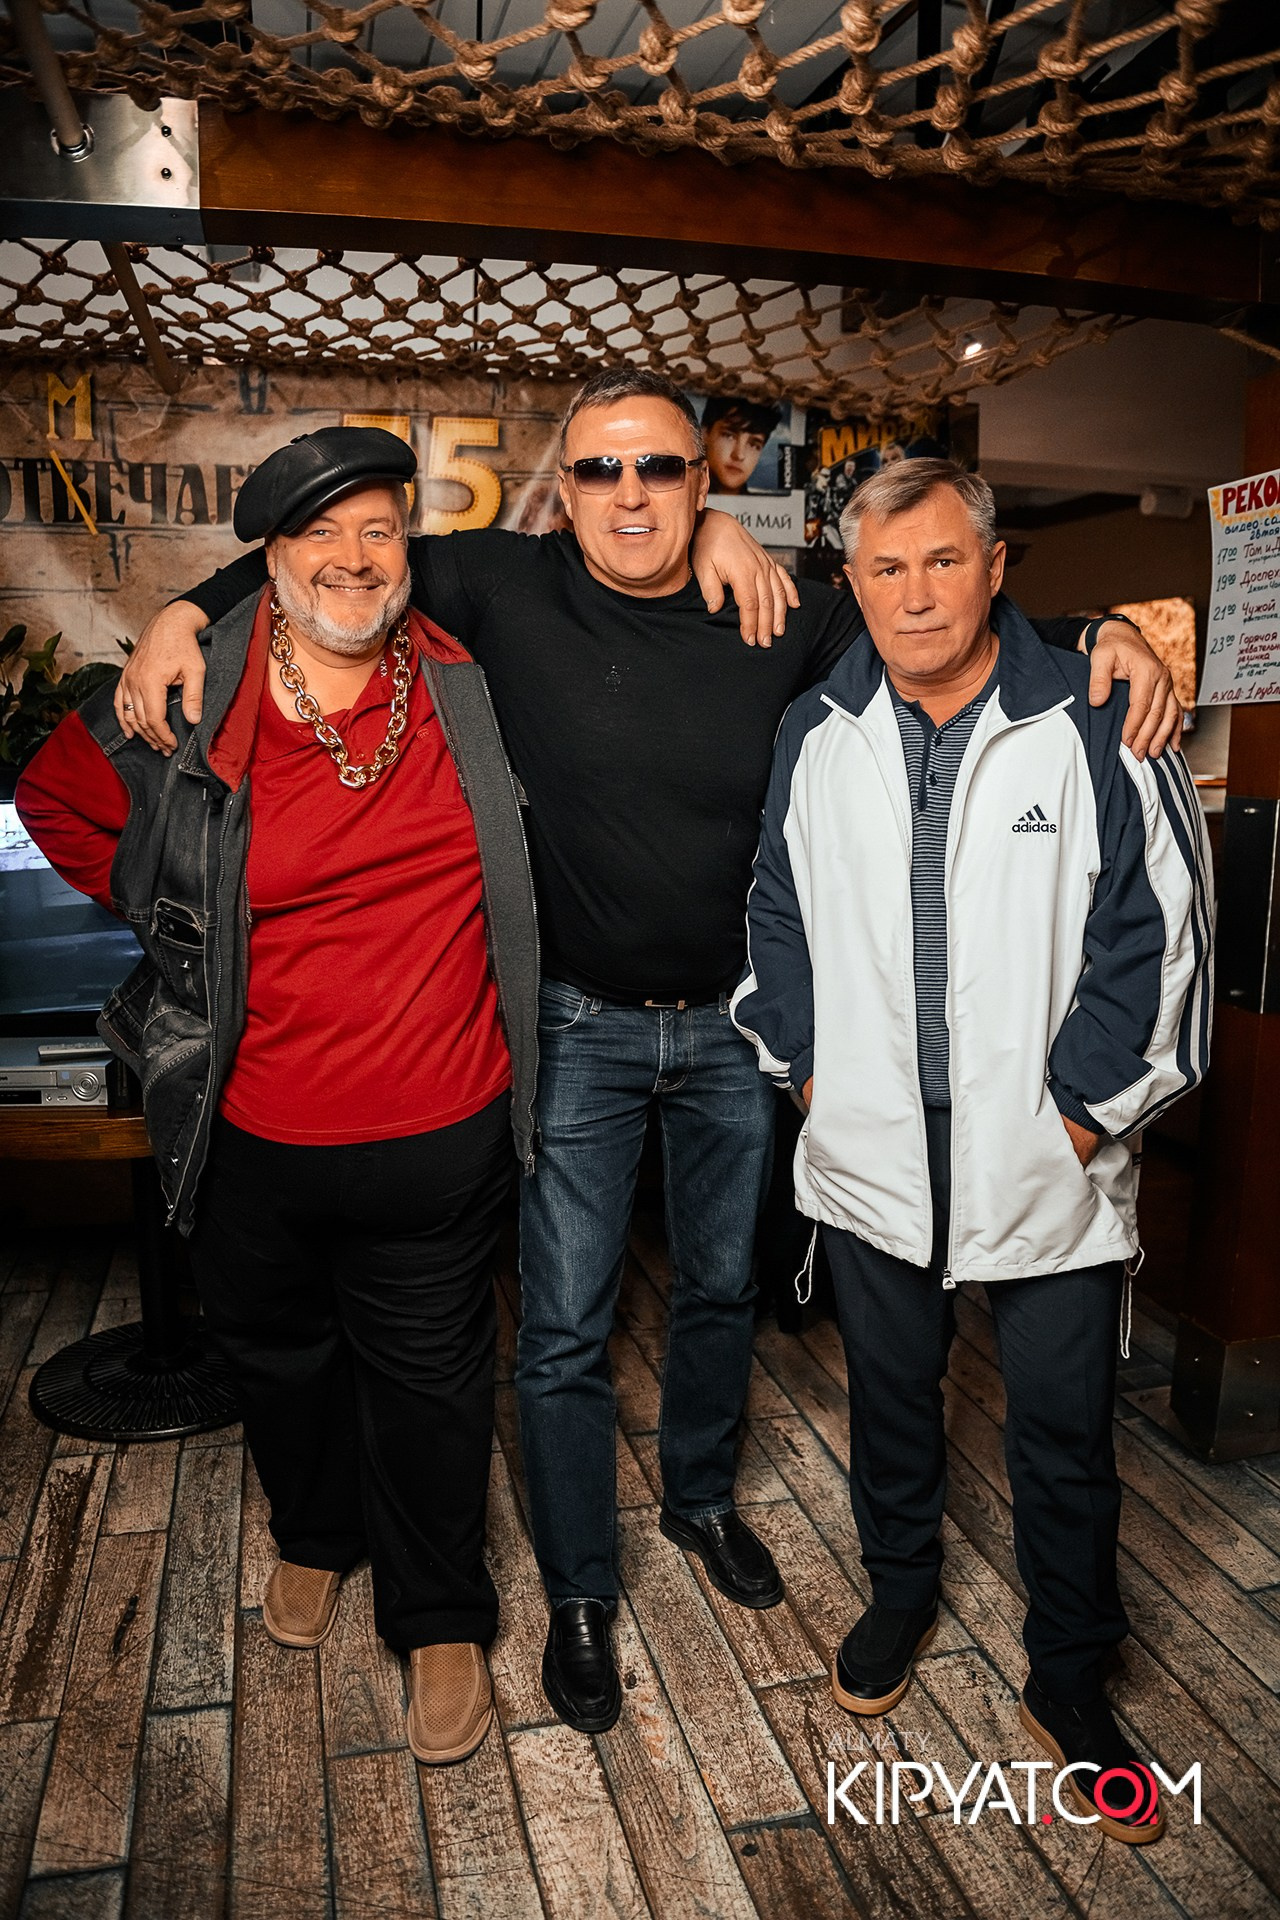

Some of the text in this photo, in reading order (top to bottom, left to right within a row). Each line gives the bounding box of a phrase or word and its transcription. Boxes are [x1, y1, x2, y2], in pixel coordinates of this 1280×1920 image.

[0, 458, 262, 524] ТВЕЧАЕ
[1222, 474, 1280, 516] РЕКО
[1244, 543, 1262, 558] Том
[1242, 599, 1276, 618] Чужой
[1011, 821, 1057, 833] adidas
